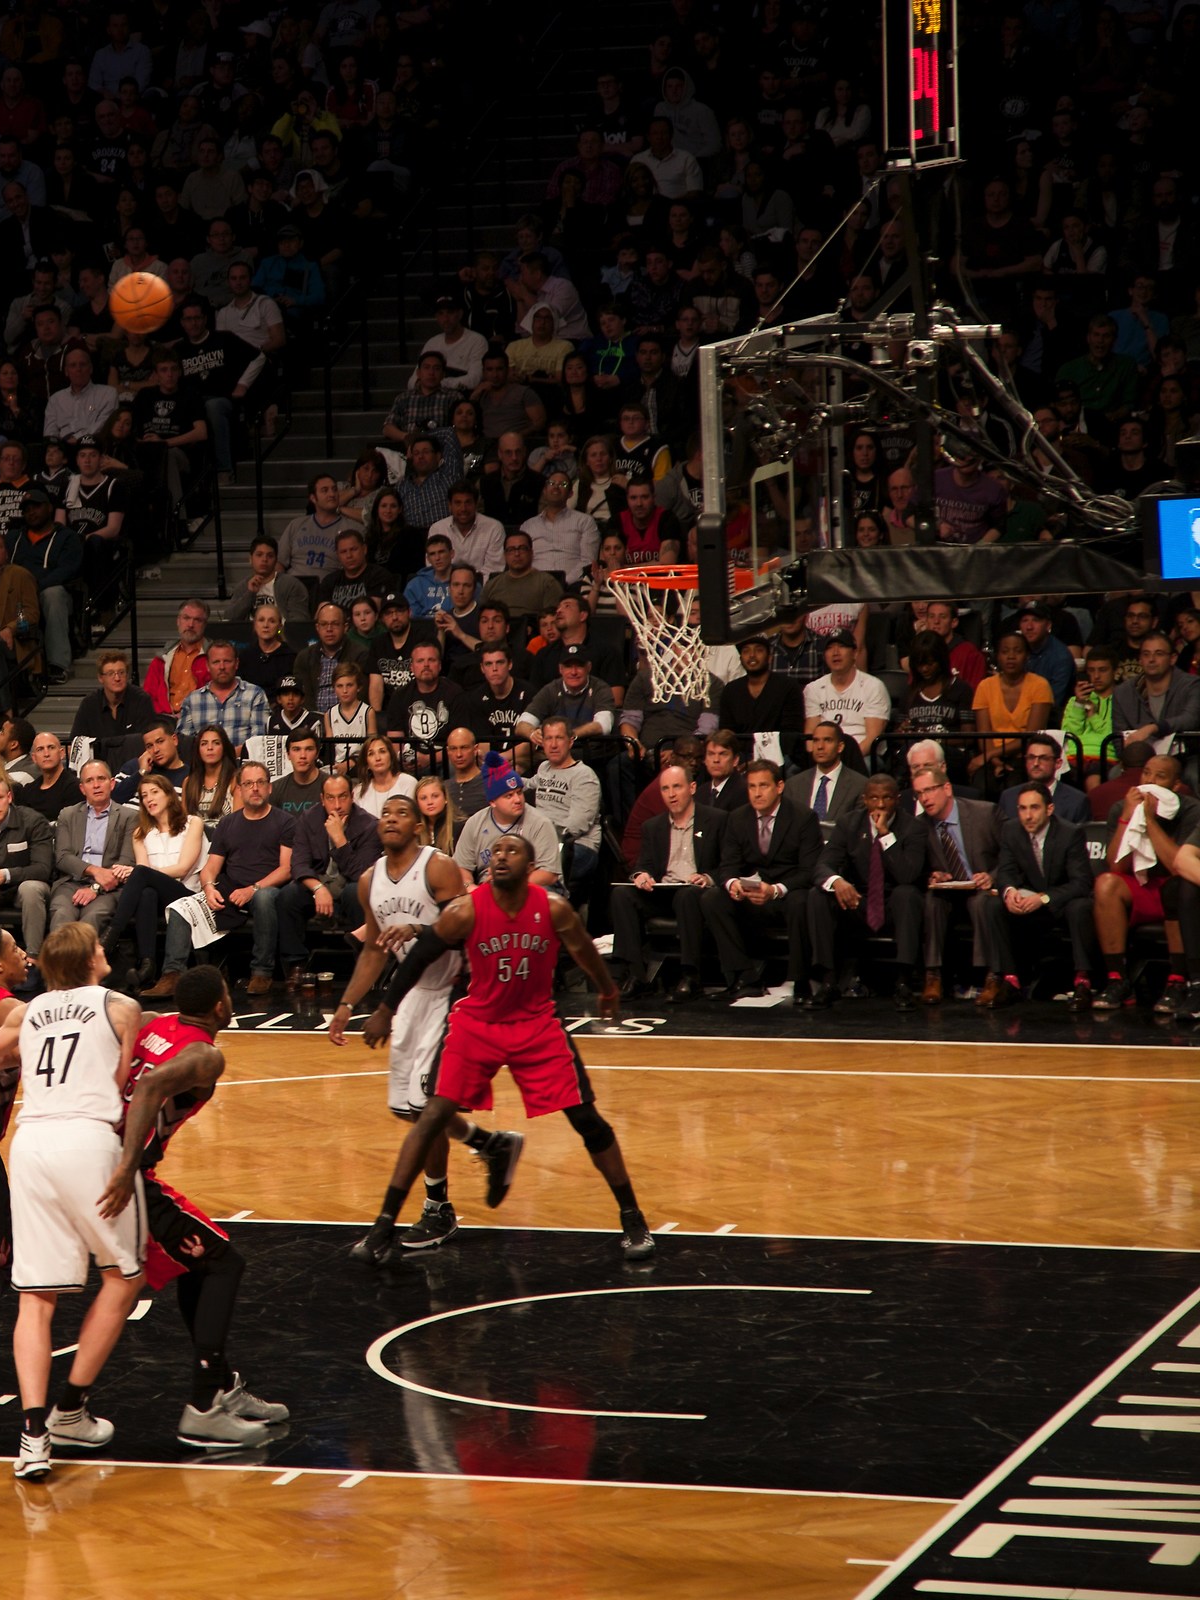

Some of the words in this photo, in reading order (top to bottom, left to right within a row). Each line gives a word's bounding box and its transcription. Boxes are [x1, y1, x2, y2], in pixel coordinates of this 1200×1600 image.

[182, 349, 224, 368] BROOKLYN
[616, 459, 647, 474] OOKLYN
[297, 535, 336, 549] BROOKLY
[306, 550, 325, 567] 34
[626, 551, 660, 564] APTOR
[390, 670, 410, 679] FOR
[908, 705, 956, 719] BROOKLYN
[477, 933, 551, 957] RAPTORS
[498, 957, 530, 982] 54
[29, 1003, 97, 1031] KIRILENKO
[36, 1032, 81, 1088] 47
